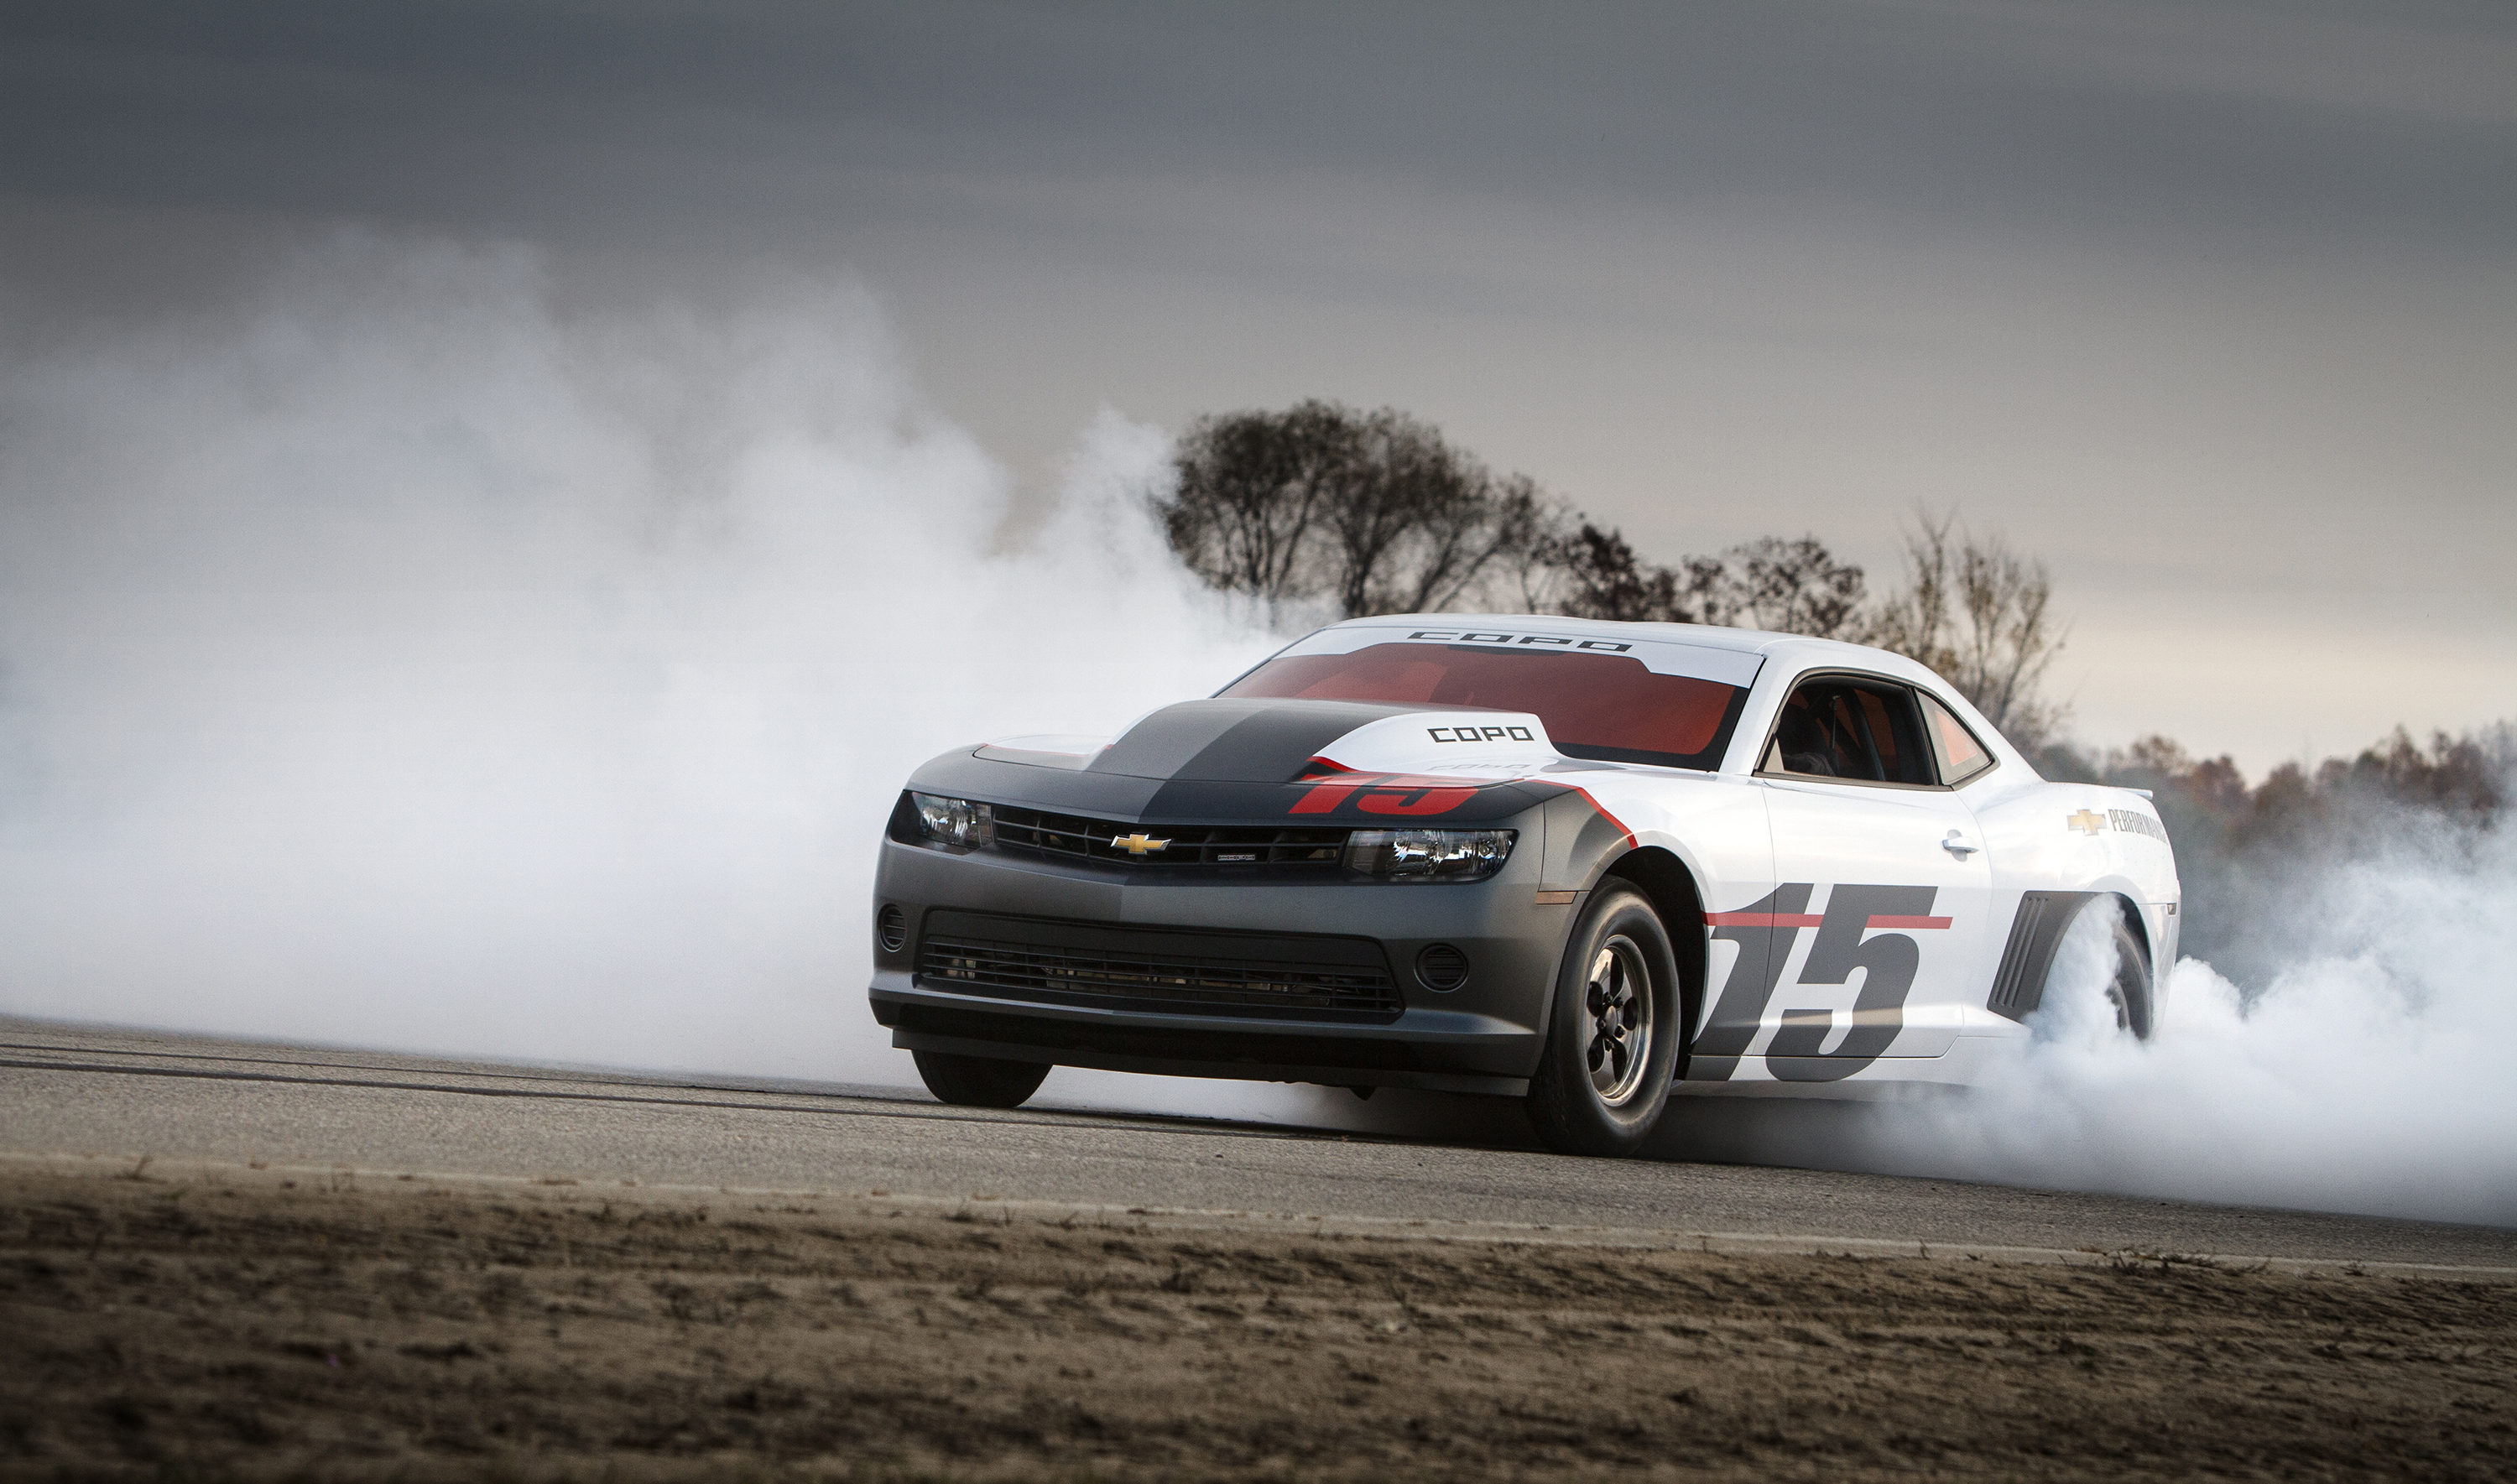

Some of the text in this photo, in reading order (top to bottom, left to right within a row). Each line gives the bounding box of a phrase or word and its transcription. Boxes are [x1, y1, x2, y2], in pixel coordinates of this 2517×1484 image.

[1407, 632, 1633, 653] COPO
[1427, 726, 1535, 743] COPO
[1288, 773, 1479, 815] 15
[1685, 883, 1939, 1083] 15
